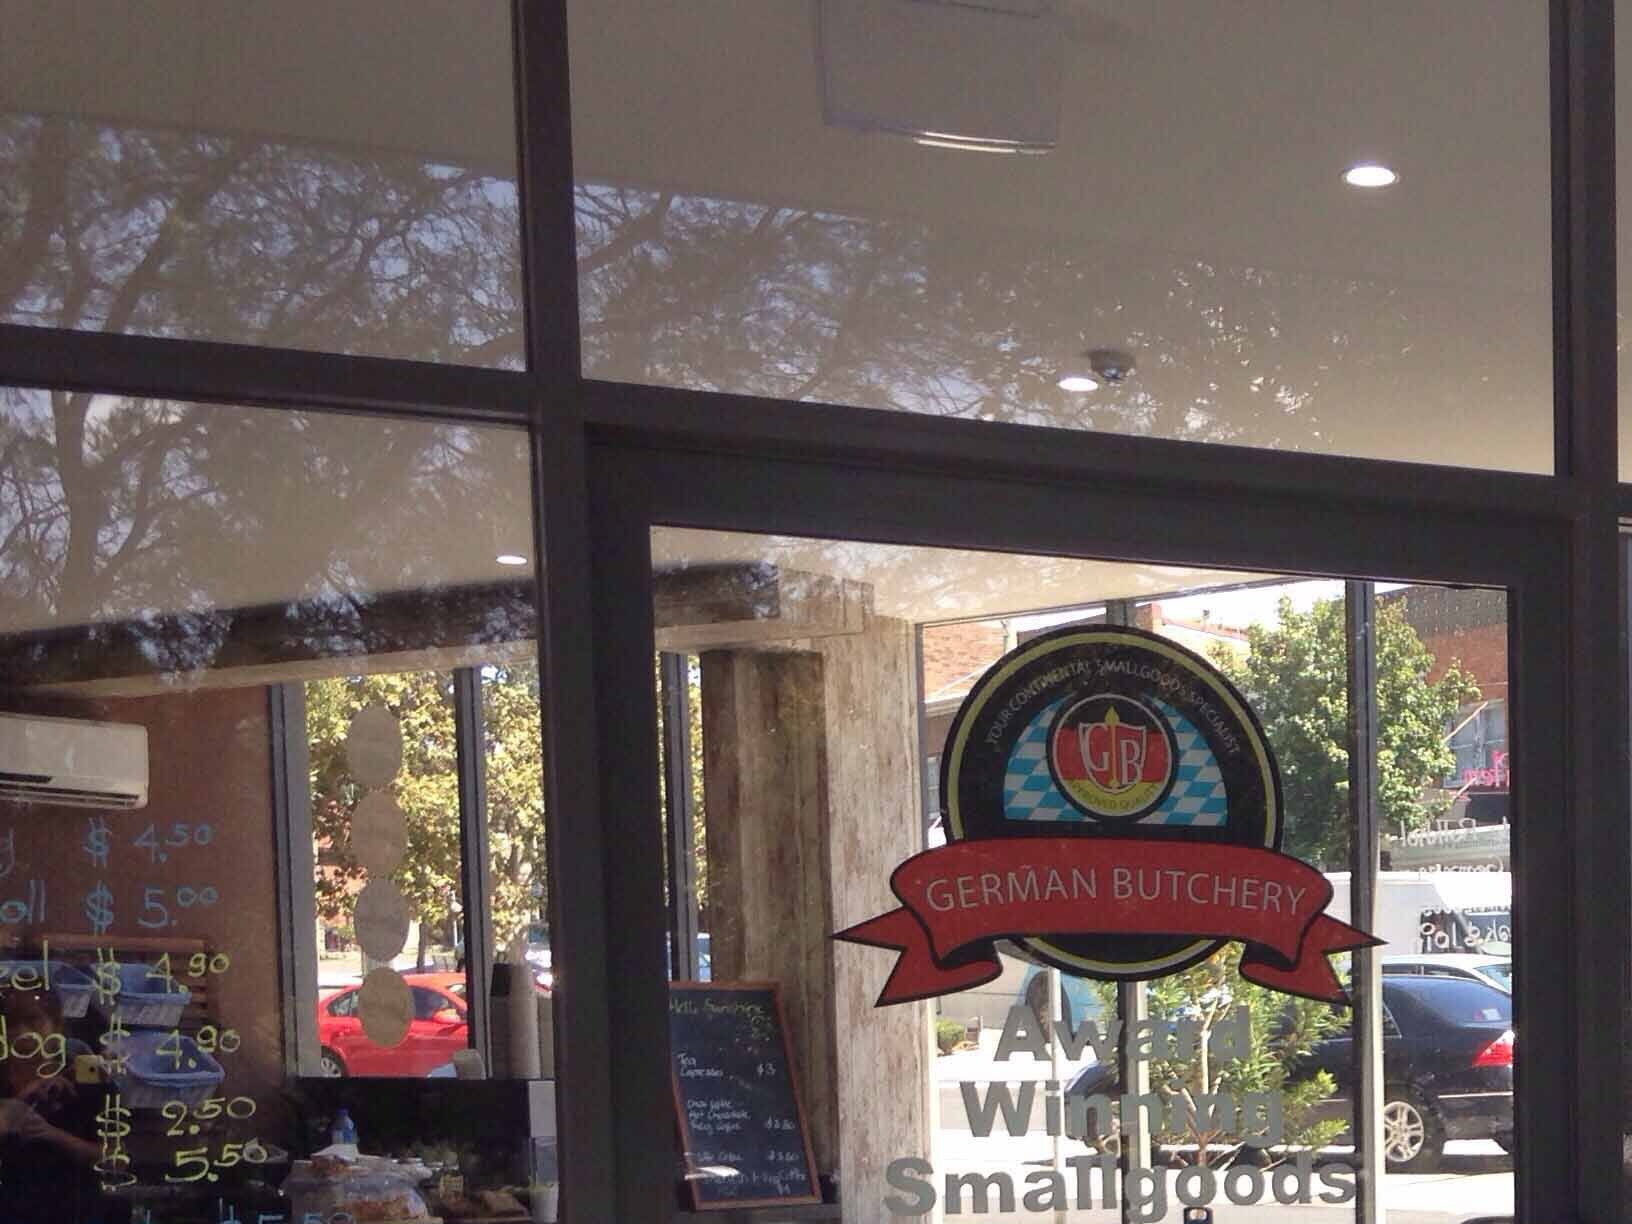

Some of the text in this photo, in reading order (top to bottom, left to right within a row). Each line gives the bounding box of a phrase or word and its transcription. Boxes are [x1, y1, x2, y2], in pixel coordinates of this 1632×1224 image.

[132, 823, 215, 864] 4.50
[136, 885, 219, 929] 5.00
[926, 867, 1307, 915] GERMAN BUTCHERY
[993, 1004, 1249, 1062] Award
[161, 1096, 257, 1137] 2.50
[960, 1079, 1283, 1149] Winning
[164, 1144, 268, 1183] 5.50
[885, 1151, 1356, 1223] Smallgoods
